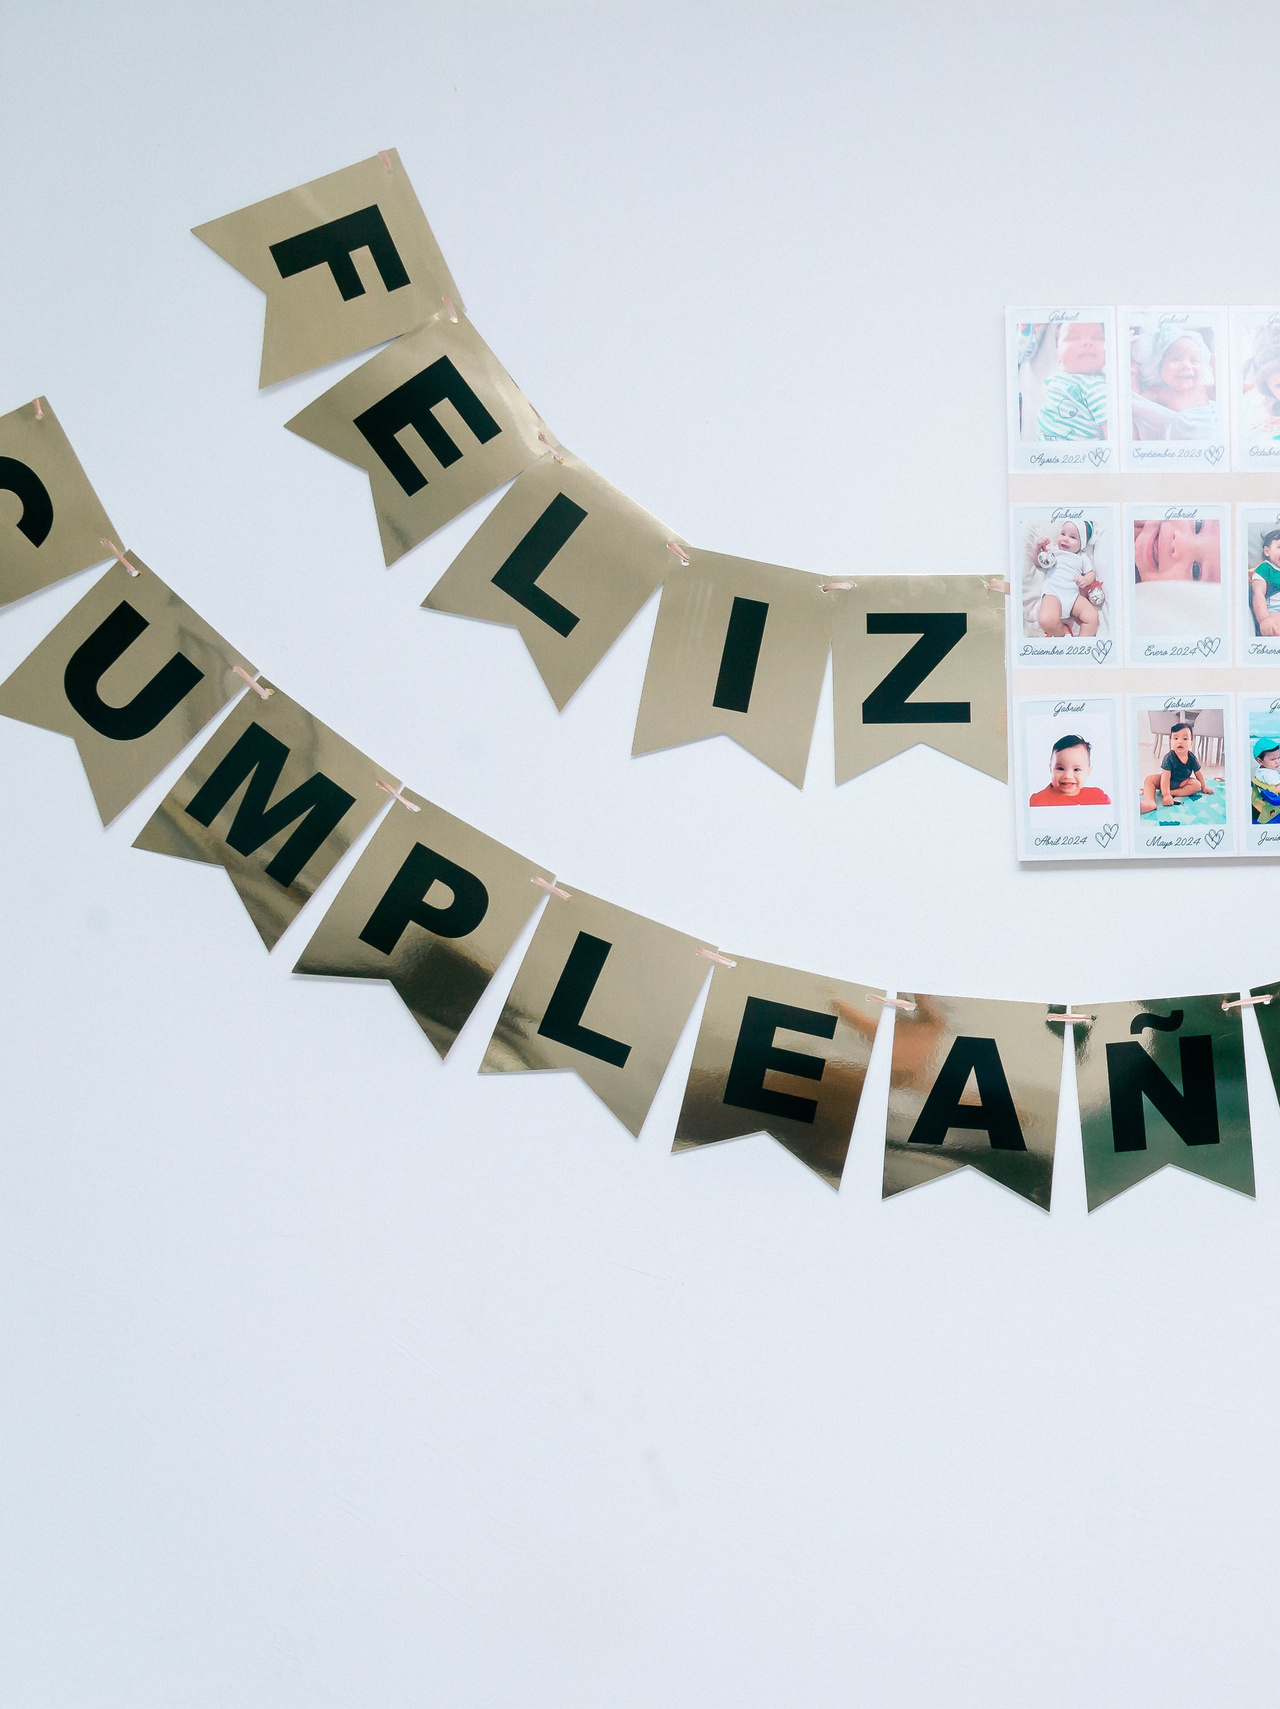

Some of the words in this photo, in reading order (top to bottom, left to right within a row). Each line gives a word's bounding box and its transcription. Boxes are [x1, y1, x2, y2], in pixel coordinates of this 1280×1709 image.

[1048, 310, 1080, 325] Gabriel
[1158, 312, 1190, 327] Gabriel
[1132, 447, 1176, 460] Septiembre
[1177, 448, 1203, 458] 2023
[1249, 445, 1280, 457] Octubre
[269, 204, 971, 725] FELIZ
[1030, 453, 1060, 466] Agosto
[1061, 454, 1086, 464] 2023
[1050, 507, 1084, 523] Gabriel
[1163, 506, 1198, 522] Gabriel
[1019, 644, 1065, 657] Diciembre
[1065, 645, 1092, 656] 2023
[1144, 645, 1168, 657] Enero
[1168, 646, 1197, 656] 2024
[1053, 701, 1086, 717] Gabriel
[1162, 697, 1196, 712] Gabriel
[1034, 835, 1061, 846] Abril
[1061, 835, 1088, 846] 2024
[1146, 835, 1173, 850] Mayo
[1174, 837, 1202, 847] 2024
[1257, 831, 1280, 846] Junio
